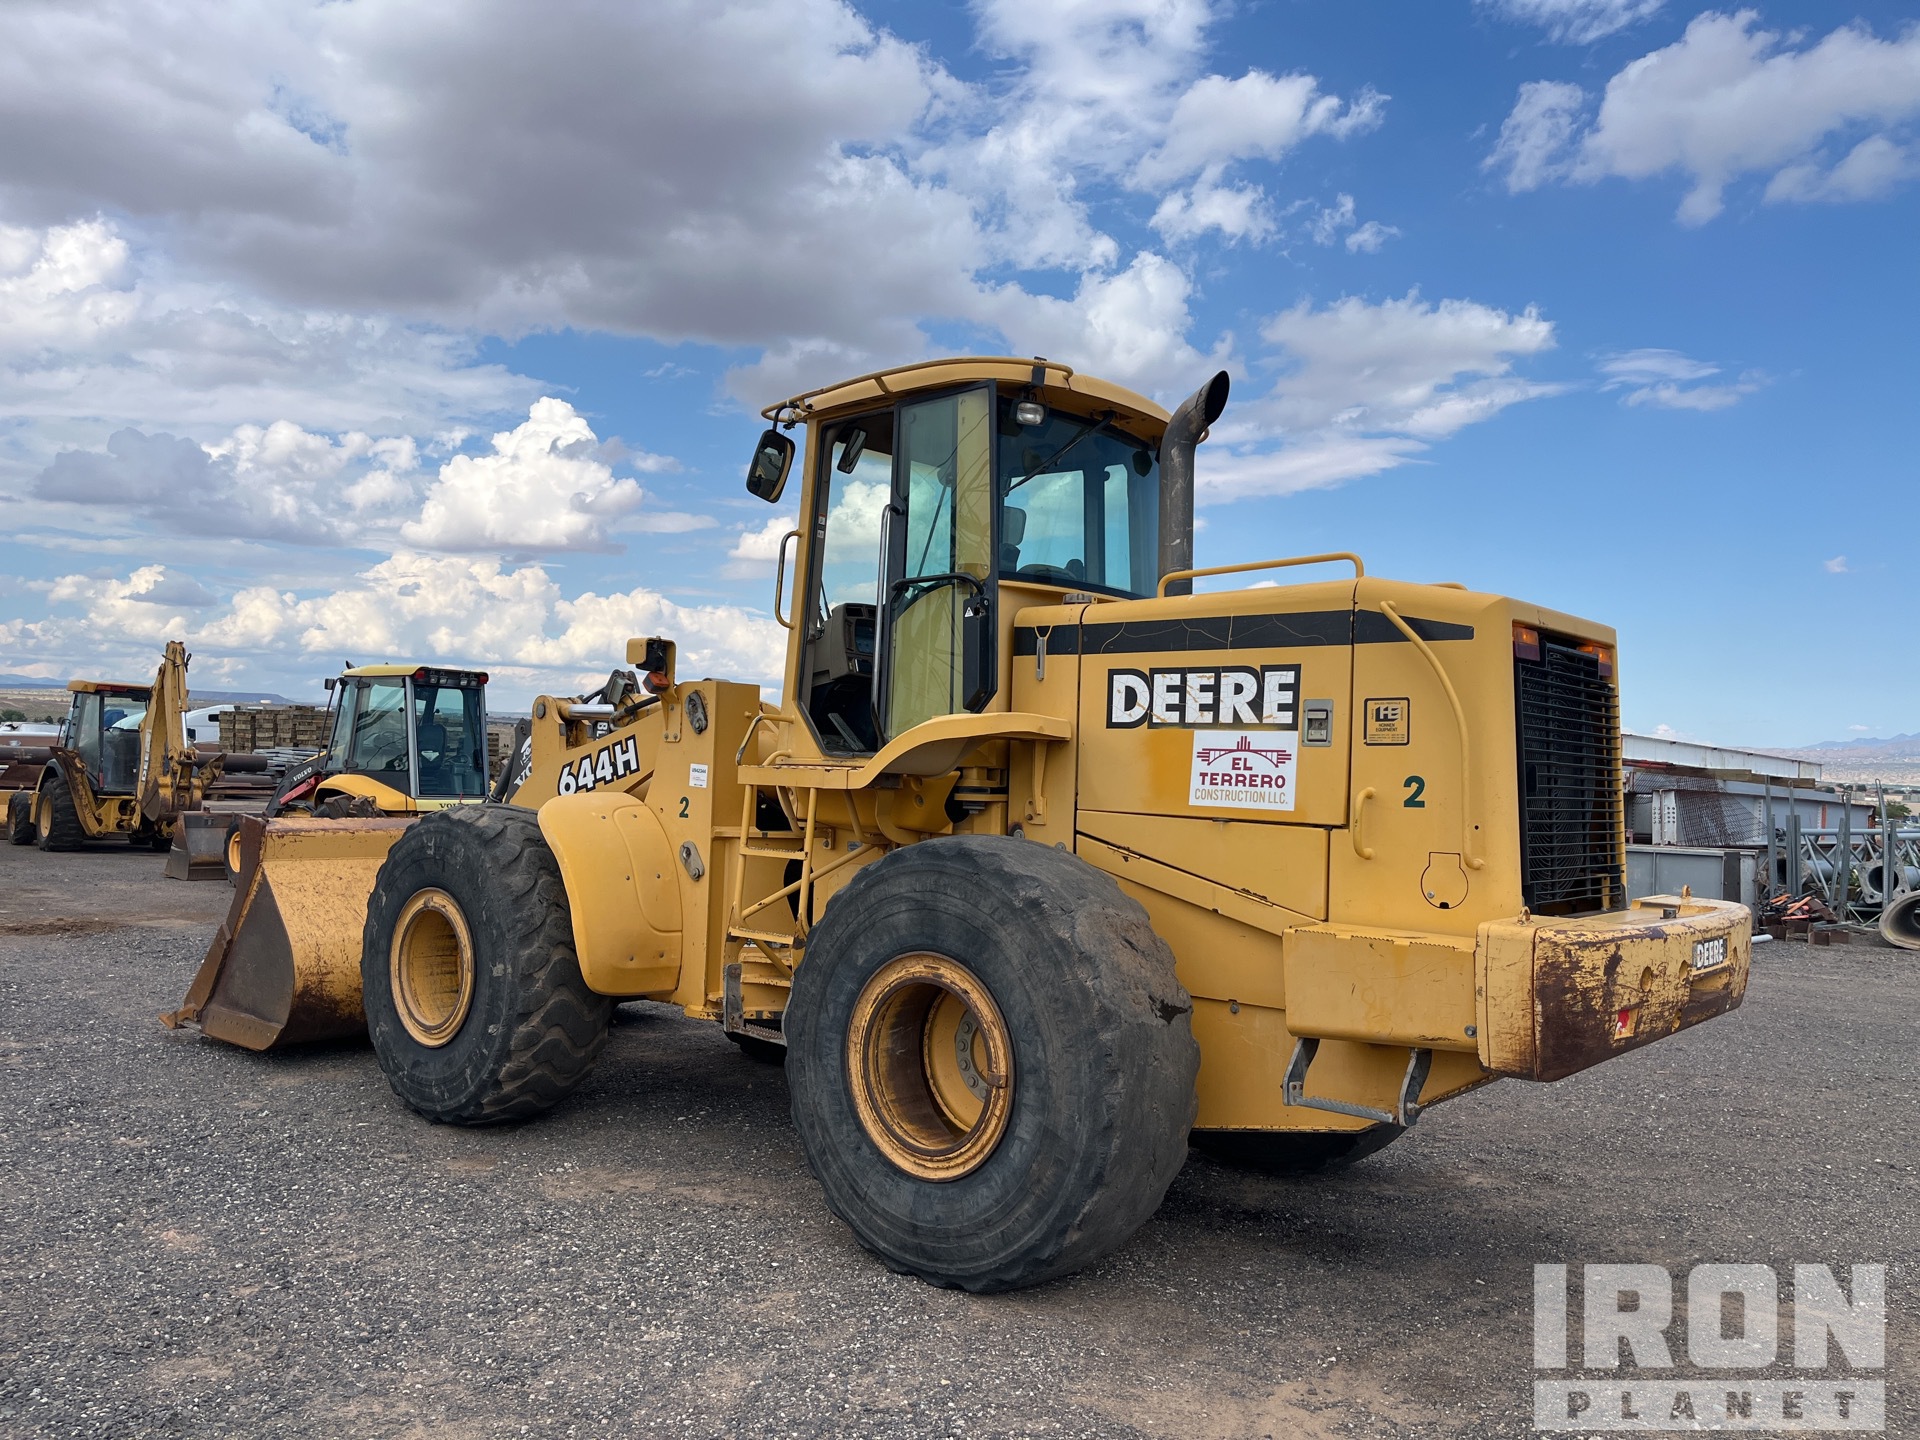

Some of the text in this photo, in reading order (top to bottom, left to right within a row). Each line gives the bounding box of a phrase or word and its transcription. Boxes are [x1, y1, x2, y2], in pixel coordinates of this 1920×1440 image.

[1111, 670, 1296, 724] DEERE
[293, 766, 312, 782] VOLVO
[559, 738, 638, 796] 644H
[1231, 757, 1253, 771] EL
[1199, 772, 1286, 789] TERRERO
[1403, 775, 1425, 808] 2
[679, 796, 689, 818] 2
[1194, 788, 1288, 804] CONSTRUCTION LLC.
[1697, 938, 1724, 968] DEERE
